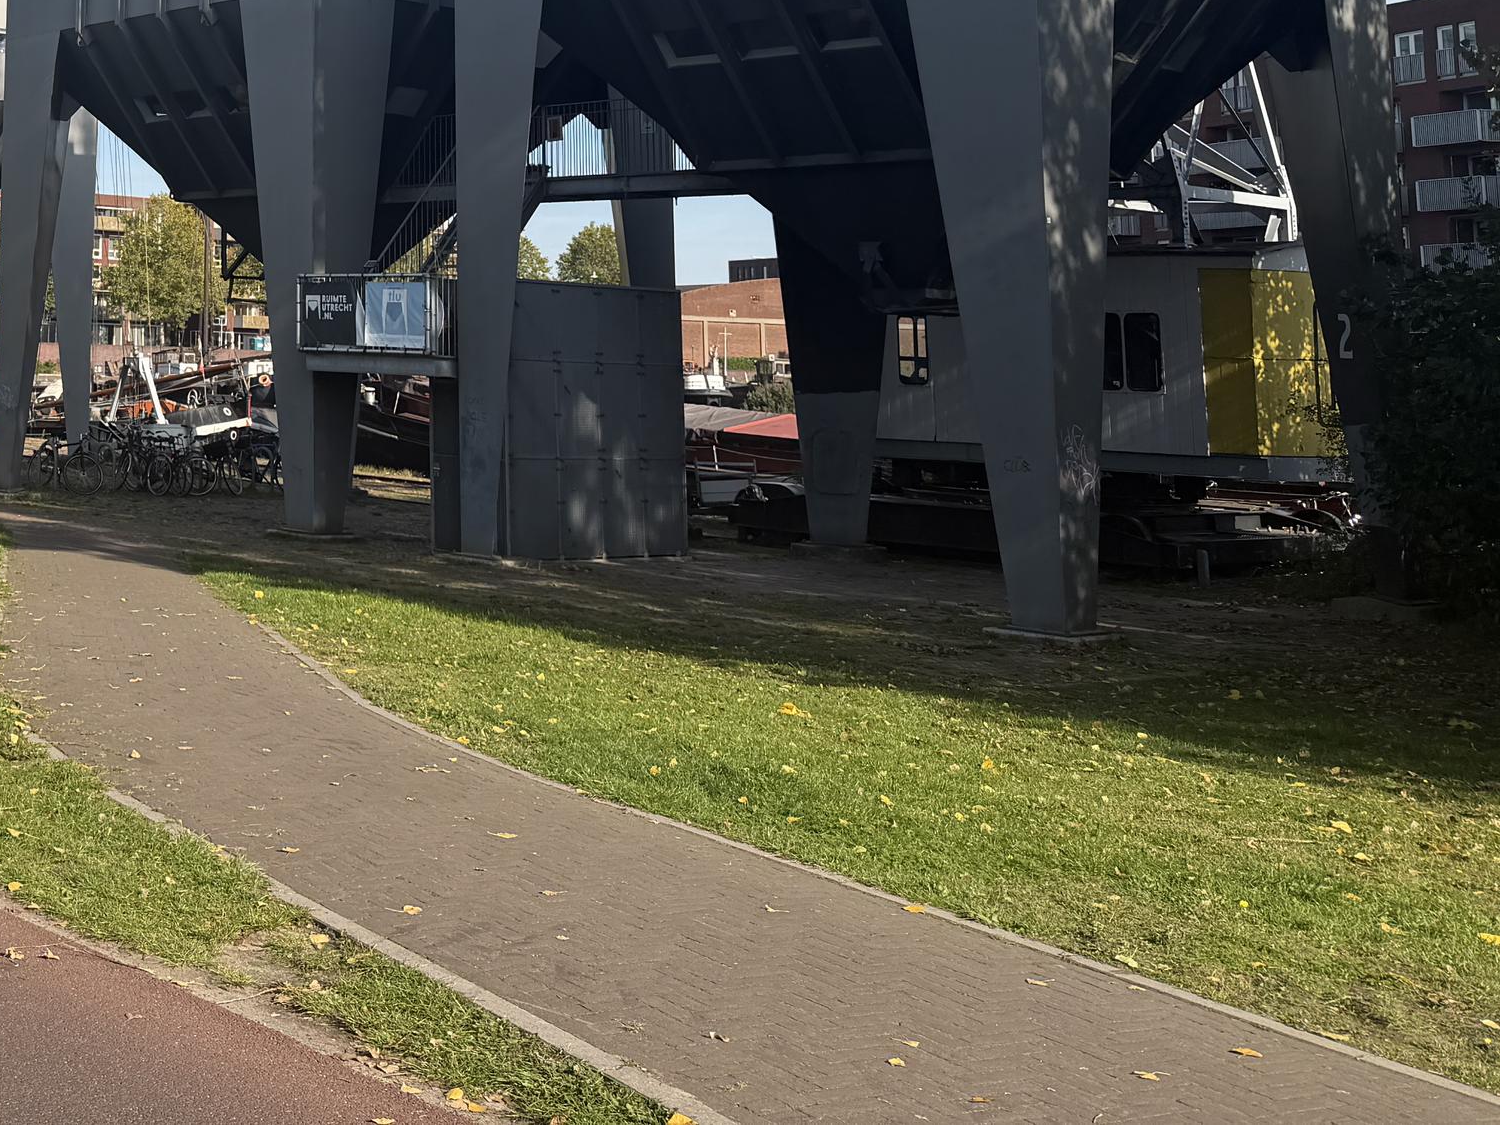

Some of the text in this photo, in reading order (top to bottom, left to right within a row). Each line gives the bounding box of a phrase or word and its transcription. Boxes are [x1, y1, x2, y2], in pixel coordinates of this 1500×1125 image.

[322, 294, 347, 303] RUIMTE
[322, 303, 352, 312] UTRECHT
[322, 312, 334, 320] .NL
[1337, 313, 1354, 359] 2
